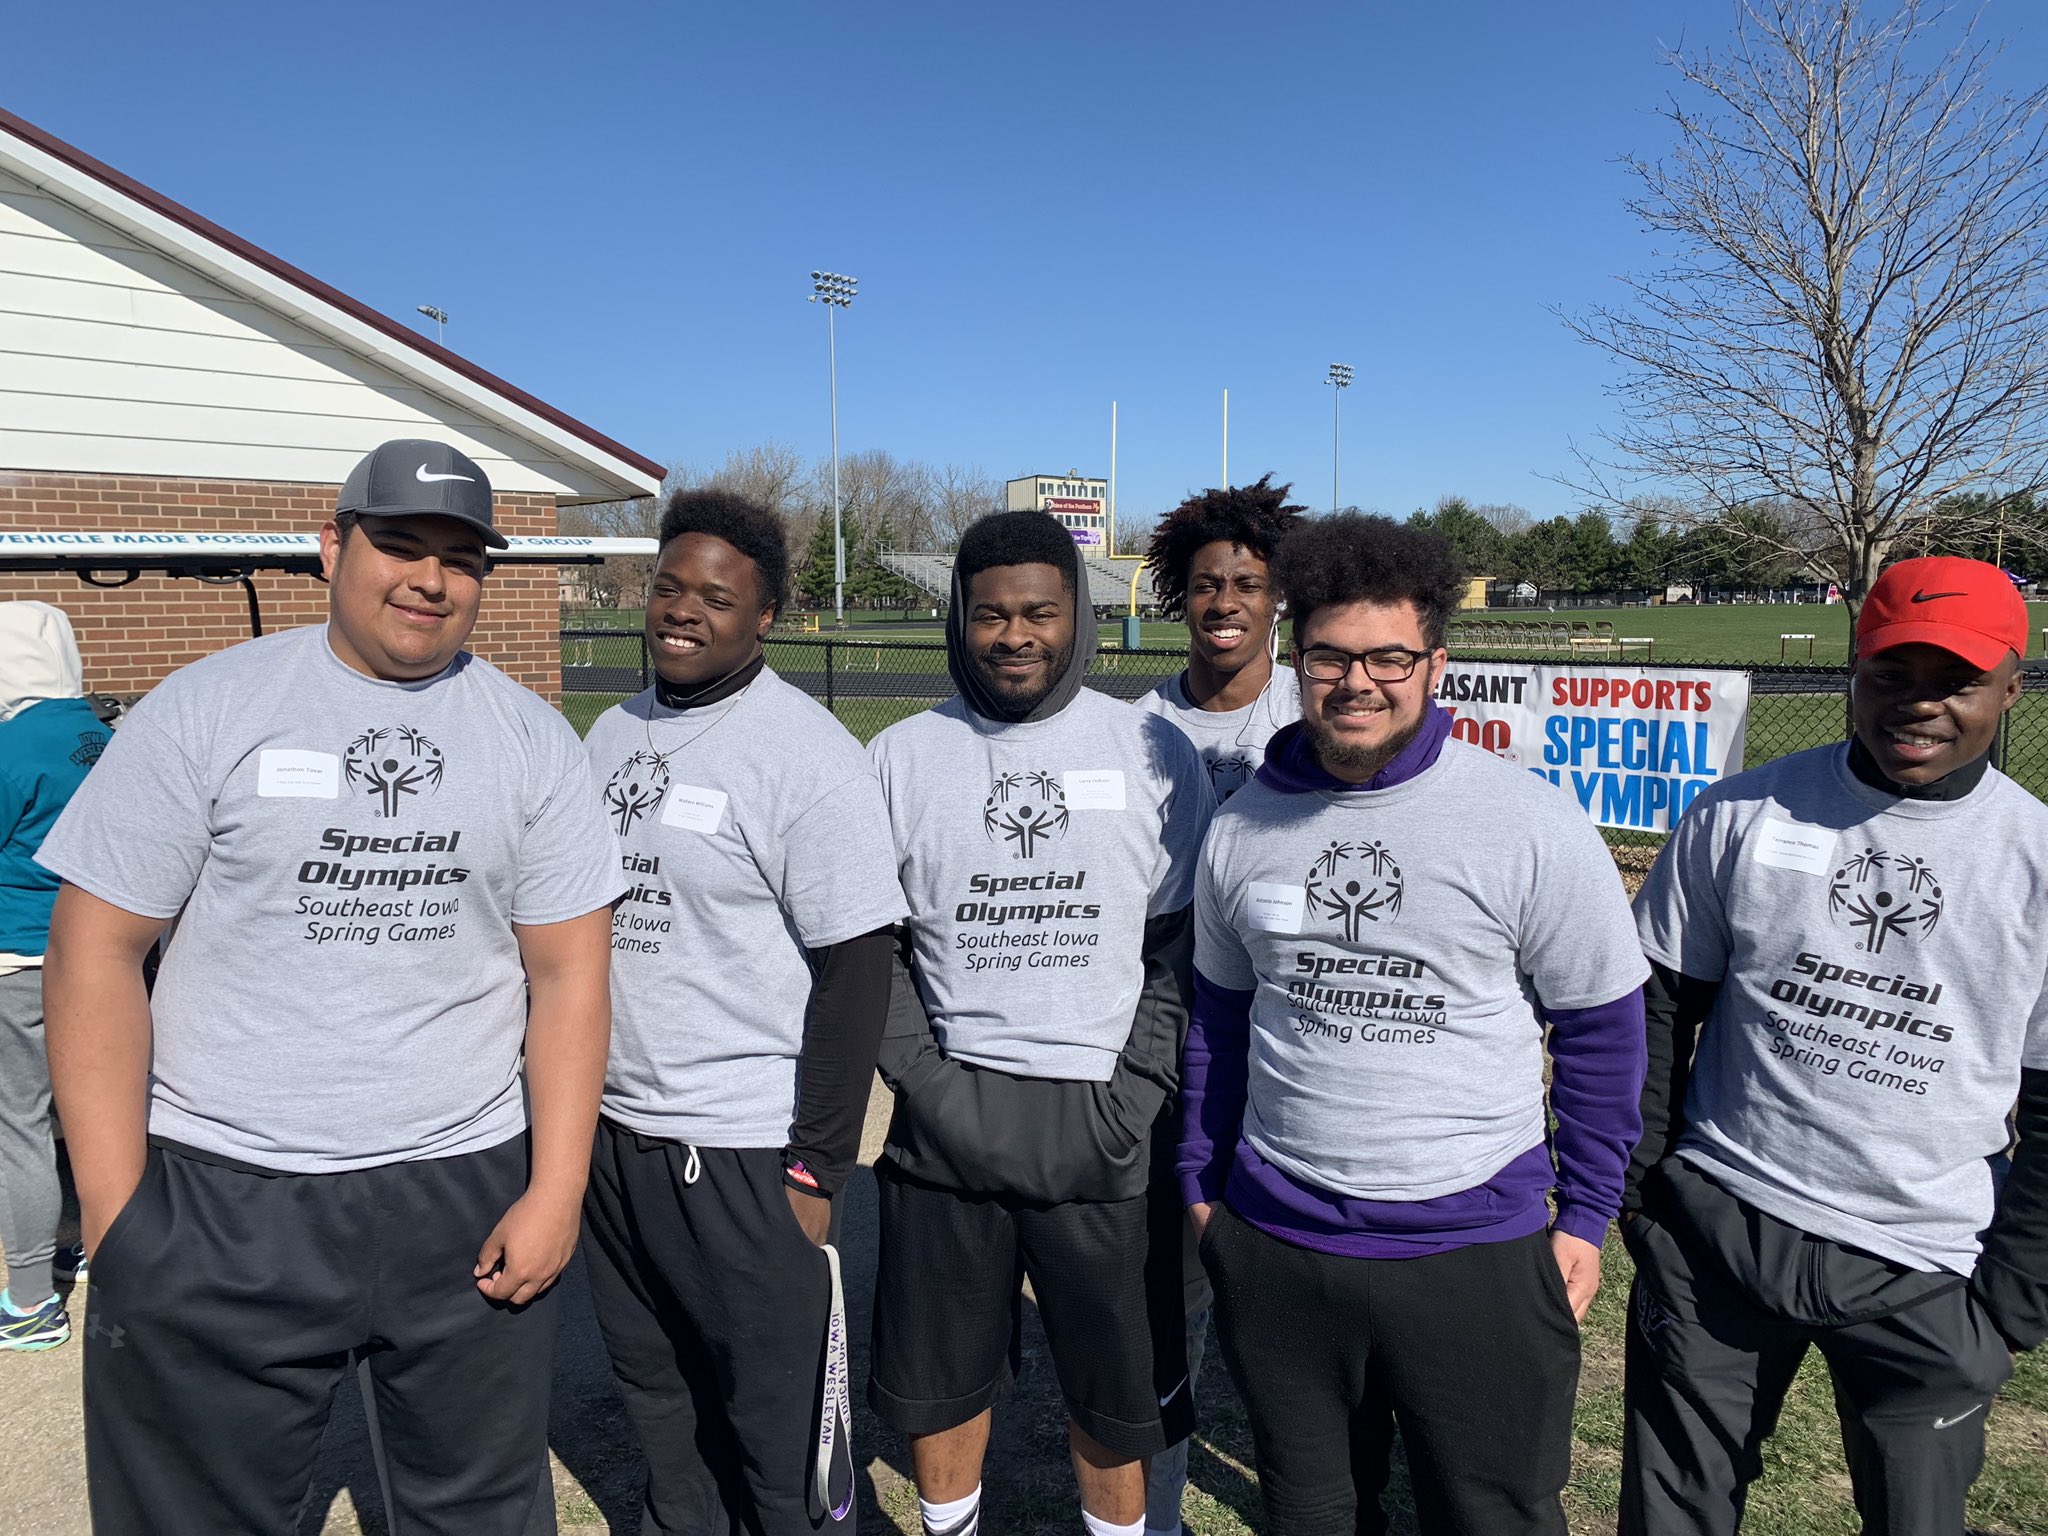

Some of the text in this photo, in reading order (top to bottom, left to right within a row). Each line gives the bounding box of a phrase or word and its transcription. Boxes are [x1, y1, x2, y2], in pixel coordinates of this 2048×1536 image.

[0, 534, 104, 543] EHICLE
[112, 535, 189, 544] MADE
[195, 535, 309, 544] POSSIBLE
[527, 537, 593, 546] GROUP
[1552, 676, 1712, 713] SUPPORTS
[1543, 715, 1718, 776] SPECIAL
[319, 828, 461, 857] Special
[298, 861, 471, 891] Olympics
[622, 852, 660, 875] cial
[969, 871, 1086, 897] Special
[295, 896, 459, 917] Southeast Iowa
[955, 900, 1101, 926] Olympics
[304, 922, 456, 945] Spring Games
[629, 913, 671, 933] Iowa
[956, 930, 1099, 949] Southeast Iowa
[965, 951, 1090, 973] Spring Games
[1295, 952, 1425, 979] Special
[1791, 951, 1943, 1006] Special
[1770, 978, 1955, 1043] Olympics
[1294, 1014, 1436, 1044] Spring Games
[1765, 1010, 1945, 1074] Southeast Iowa
[1769, 1036, 1929, 1096] Spring Games
[822, 1313, 840, 1445] IOWA WESLEYAN
